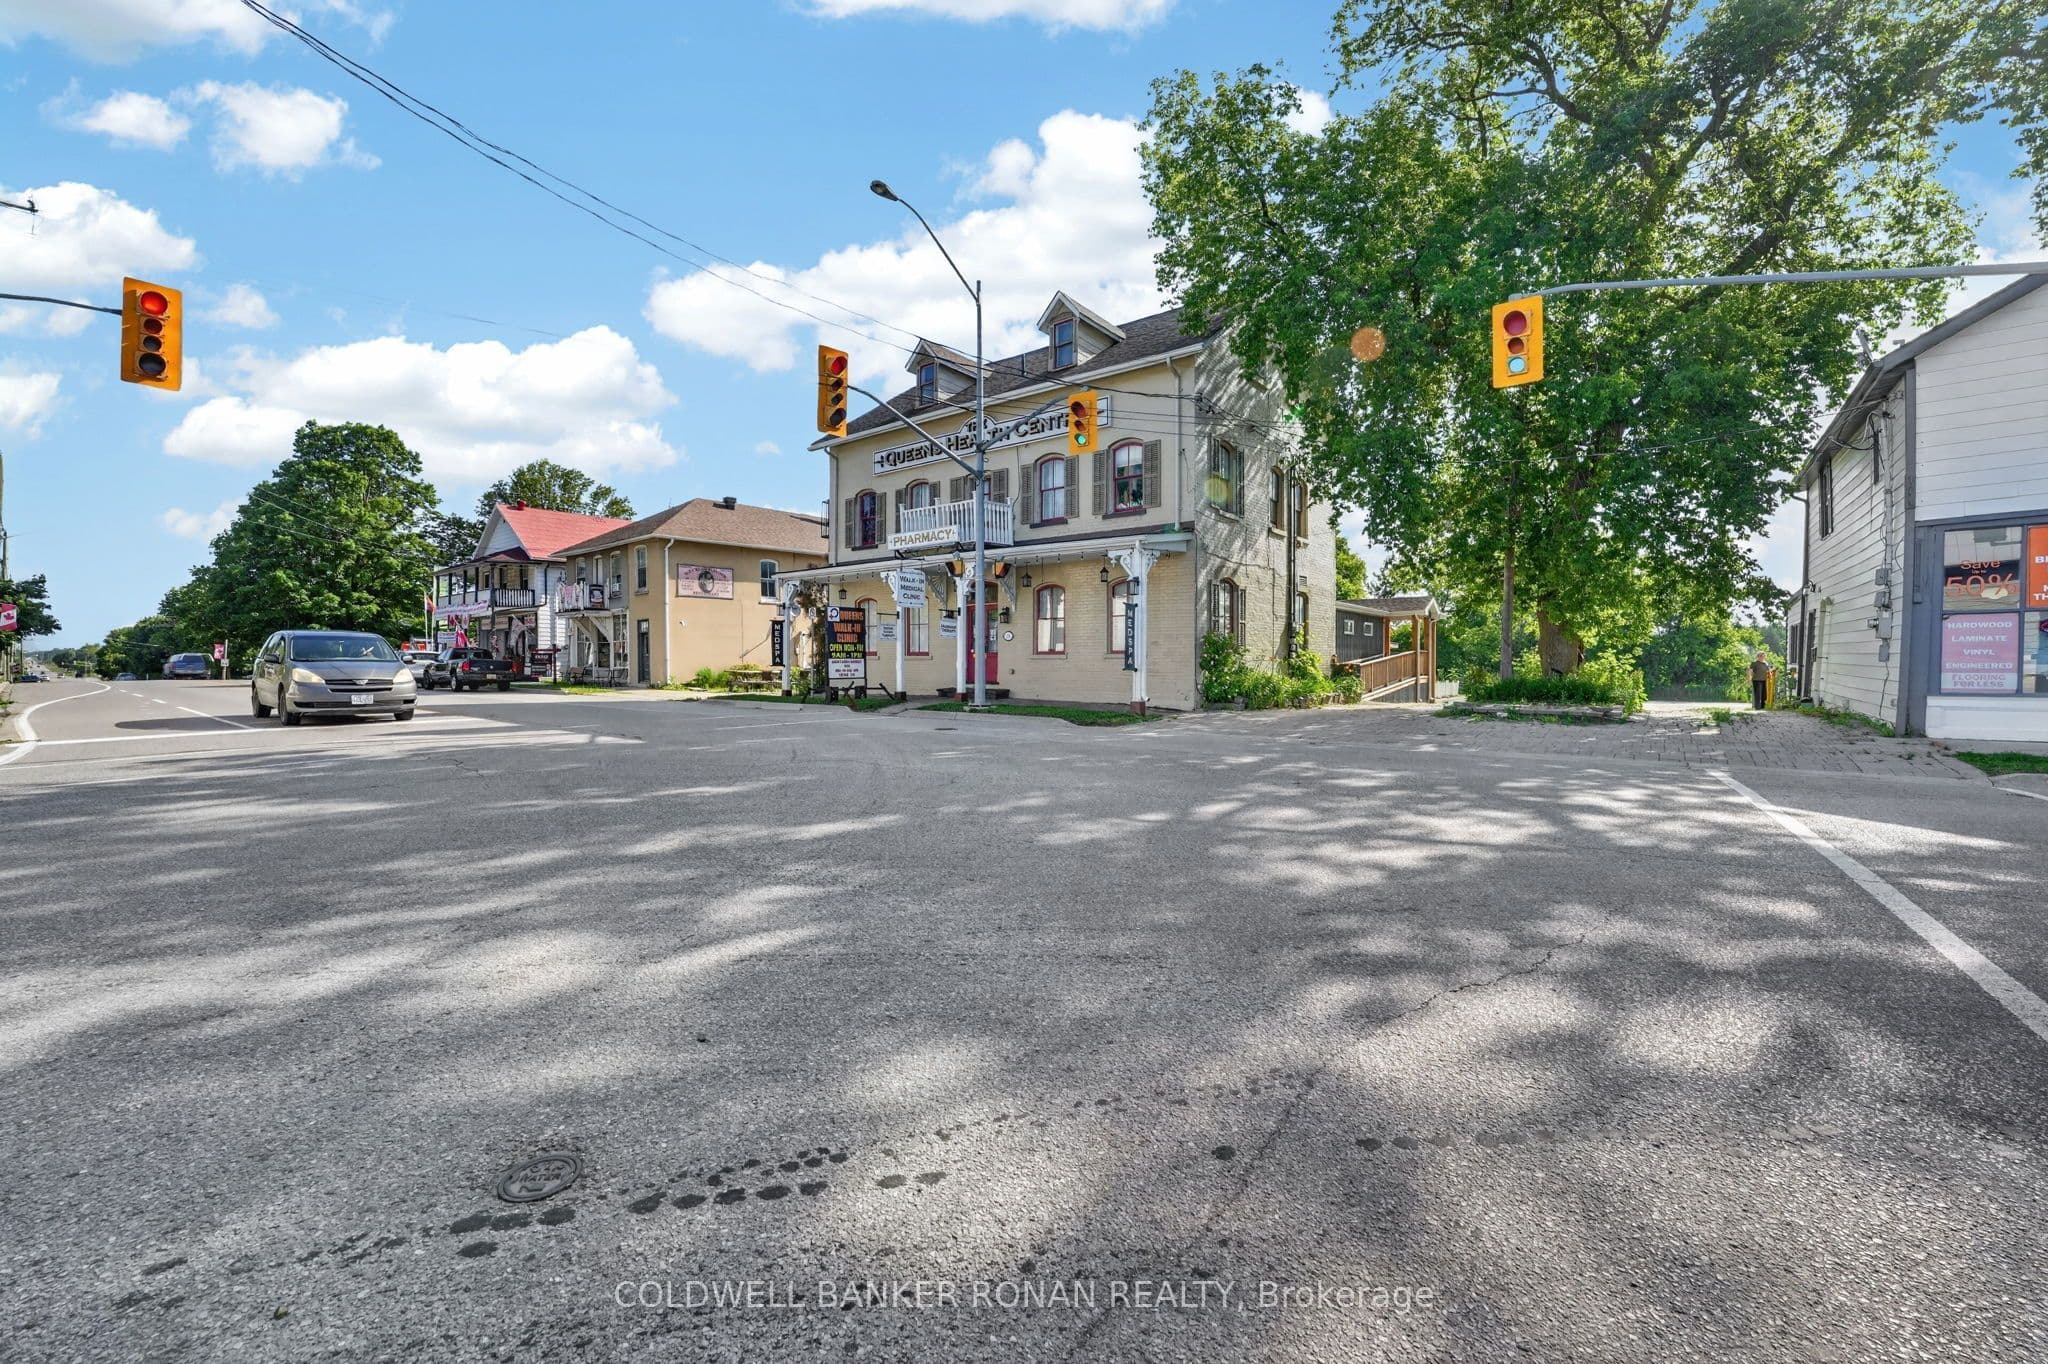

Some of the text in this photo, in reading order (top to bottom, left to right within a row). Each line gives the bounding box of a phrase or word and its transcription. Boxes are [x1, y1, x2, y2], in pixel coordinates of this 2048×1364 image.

[945, 426, 1011, 451] HEATH
[1015, 412, 1069, 438] CENT
[893, 528, 953, 547] PHARMACY
[1960, 560, 2001, 570] Save
[1946, 573, 2017, 598] 50%
[902, 592, 921, 600] CLINIC
[1948, 621, 2013, 629] HARDWOOD
[836, 633, 858, 643] CLINIC
[829, 643, 843, 652] OPEN
[1963, 648, 1996, 656] VINYL
[1952, 673, 2006, 681] FLOORING
